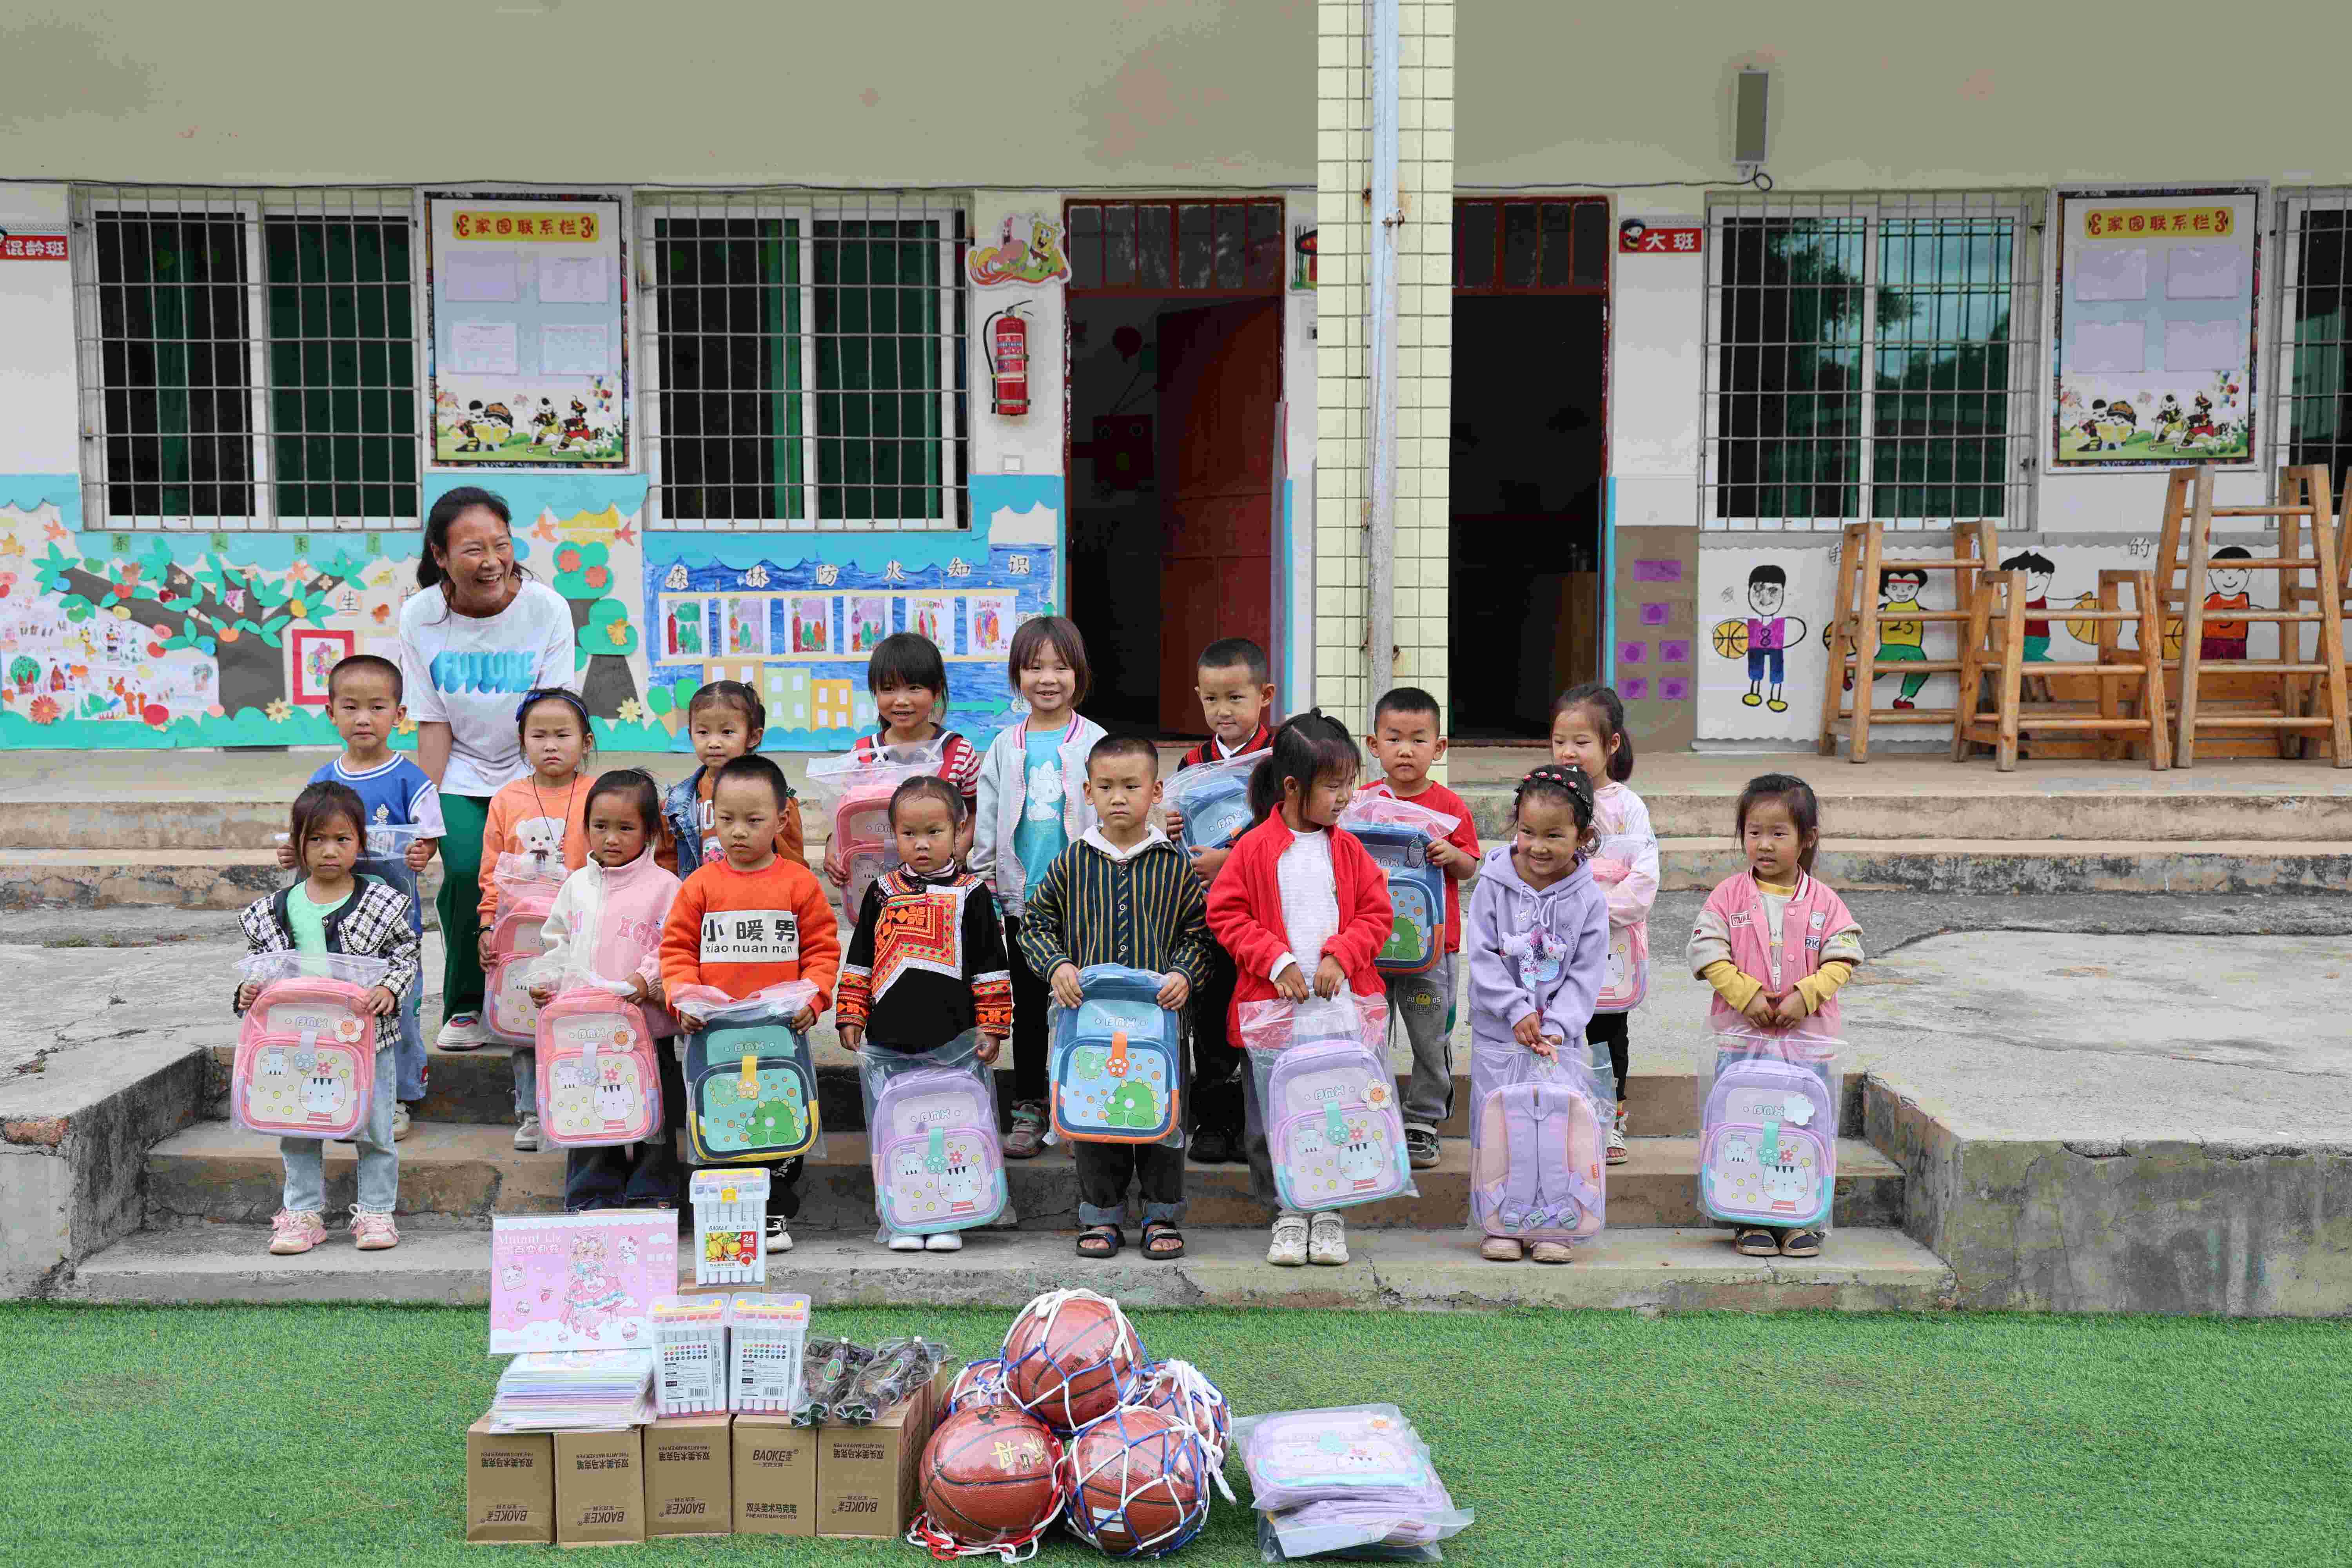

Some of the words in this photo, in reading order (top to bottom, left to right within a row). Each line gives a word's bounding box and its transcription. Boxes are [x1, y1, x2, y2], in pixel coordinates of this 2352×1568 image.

[475, 218, 577, 235] 家园联系栏
[2107, 214, 2210, 230] 家园联系栏
[1645, 232, 1694, 250] 大班
[6, 240, 65, 256] 混龄班
[1760, 628, 1771, 646] 8
[432, 650, 536, 693] FUTURE
[703, 919, 795, 942] 小暖男
[659, 1452, 710, 1461] 双头美术马克笔
[753, 1450, 785, 1461] BAOKE
[833, 1450, 884, 1459] 双头美术马克笔
[481, 1458, 533, 1468] 双头美术马克笔
[577, 1459, 629, 1470] 双头美术马克笔
[672, 1503, 705, 1514] BAOKE
[746, 1503, 797, 1514] 双头美术马克笔
[845, 1502, 878, 1512] BAOKE
[494, 1510, 527, 1521] BAOKE
[590, 1512, 624, 1524] BAOKE
